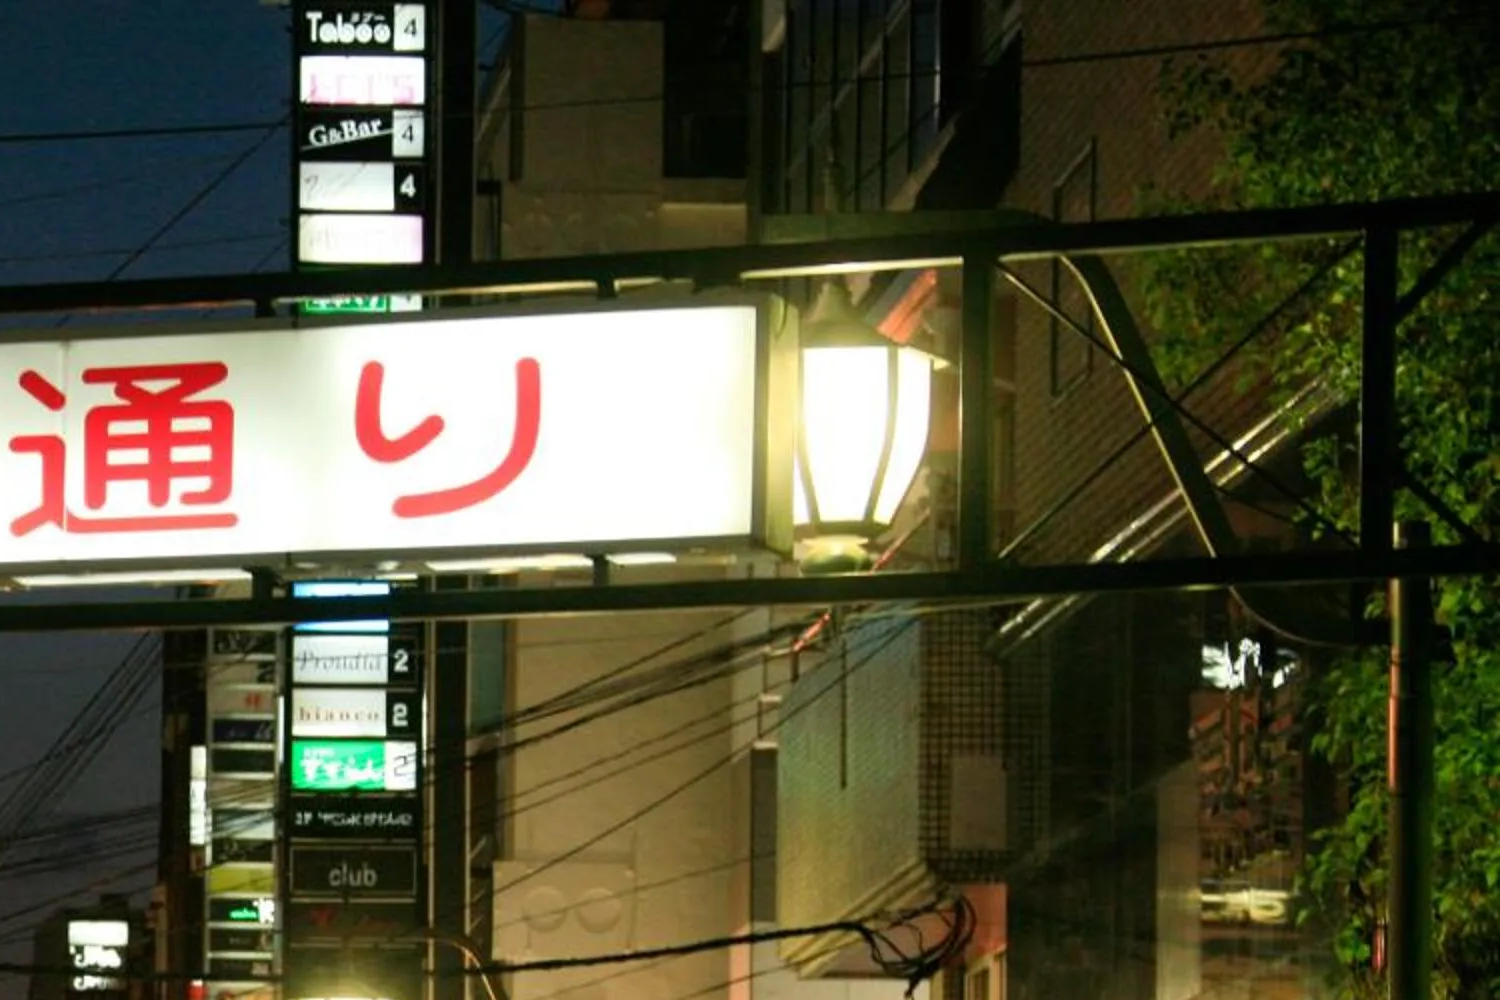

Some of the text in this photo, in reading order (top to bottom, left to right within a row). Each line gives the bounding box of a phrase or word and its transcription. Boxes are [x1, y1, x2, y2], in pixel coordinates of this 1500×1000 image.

[306, 12, 391, 43] Taboo
[403, 18, 417, 36] 4
[308, 118, 382, 147] G&Bar
[401, 125, 414, 144] 4
[400, 174, 416, 197] 4
[393, 649, 409, 672] 2
[392, 703, 409, 727] 2
[393, 755, 408, 778] 2
[328, 864, 377, 887] club
